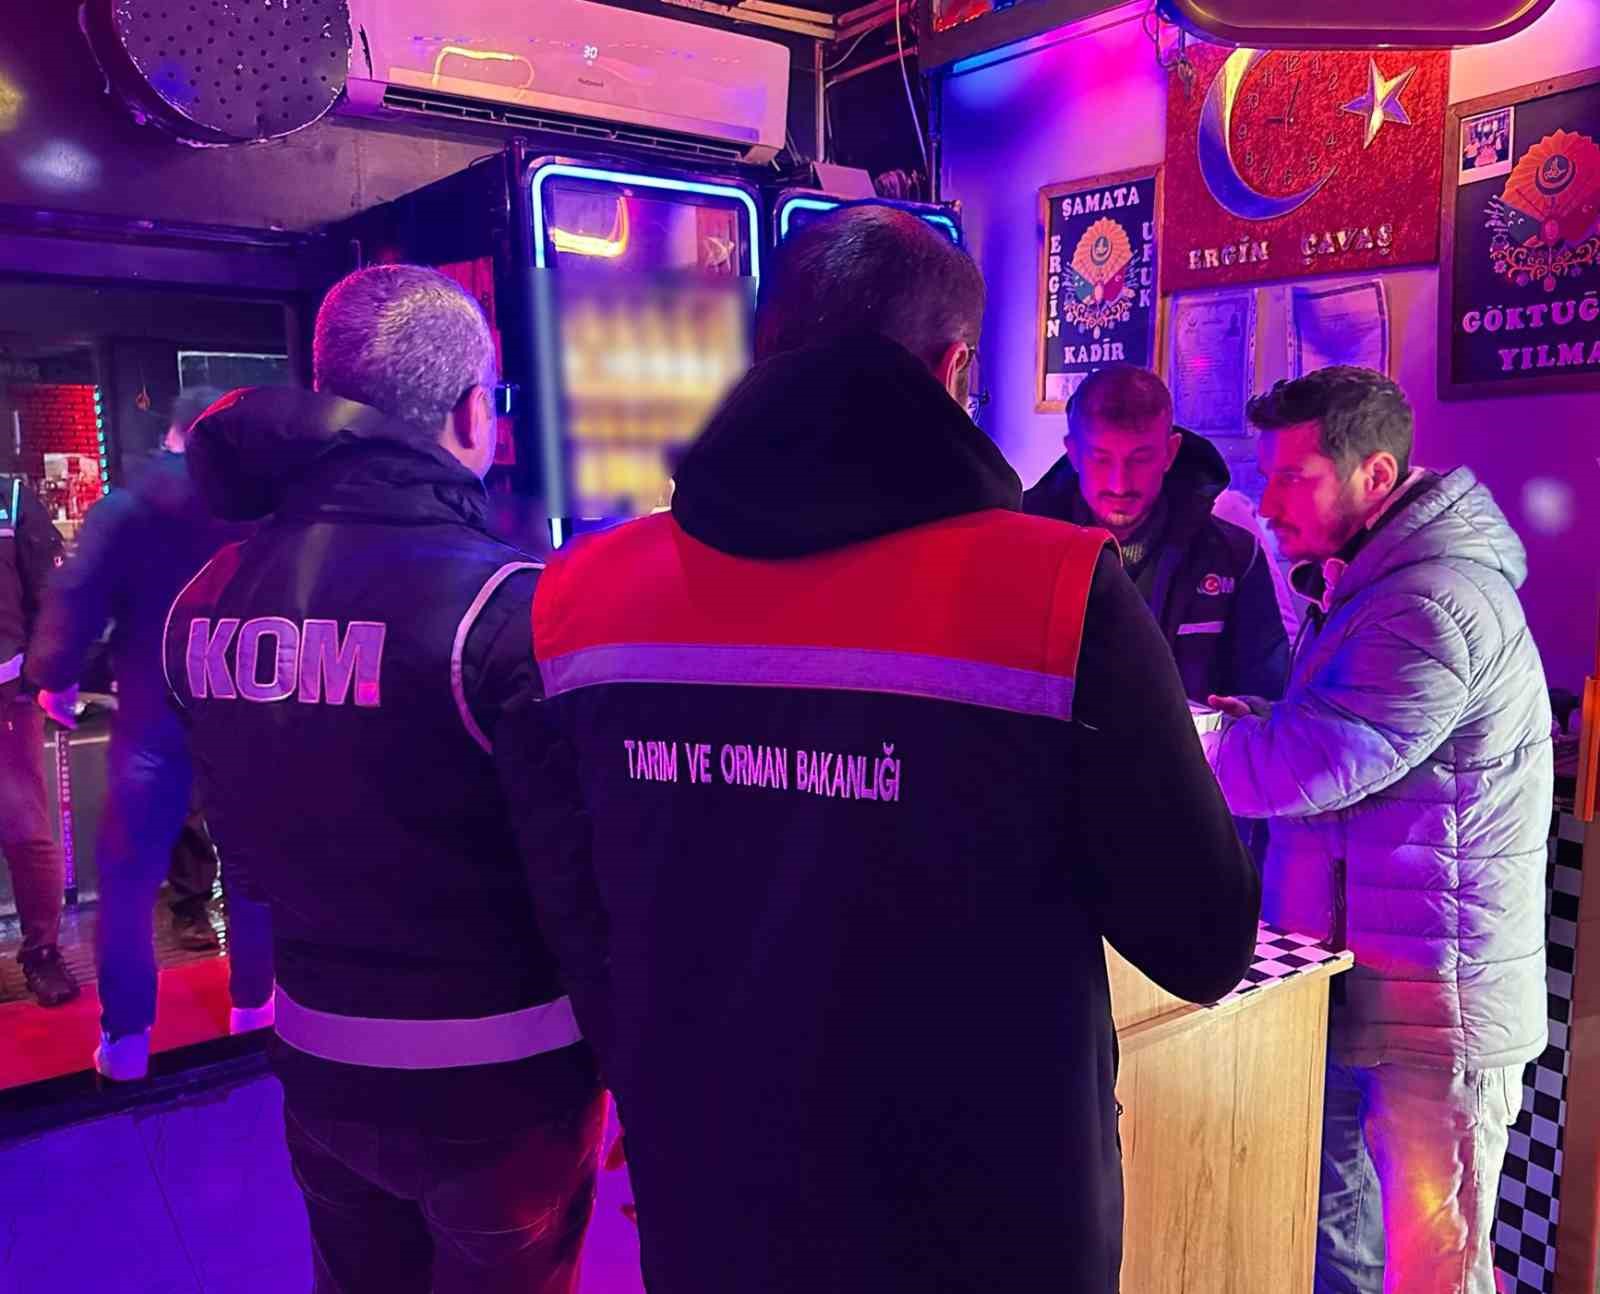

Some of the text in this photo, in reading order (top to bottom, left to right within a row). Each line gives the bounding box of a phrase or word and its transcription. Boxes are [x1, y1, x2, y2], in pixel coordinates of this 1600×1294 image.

[583, 45, 598, 59] 30
[1061, 186, 1140, 220] ŞAMATA
[1046, 235, 1063, 338] ERGİN
[1138, 221, 1154, 307] UFUK
[1462, 290, 1600, 334] GÖKTUĞ
[1063, 338, 1125, 365] KADİR
[186, 616, 386, 707] KOM
[623, 739, 901, 802] TARIM VE ORMAN BAKANLIĞI
